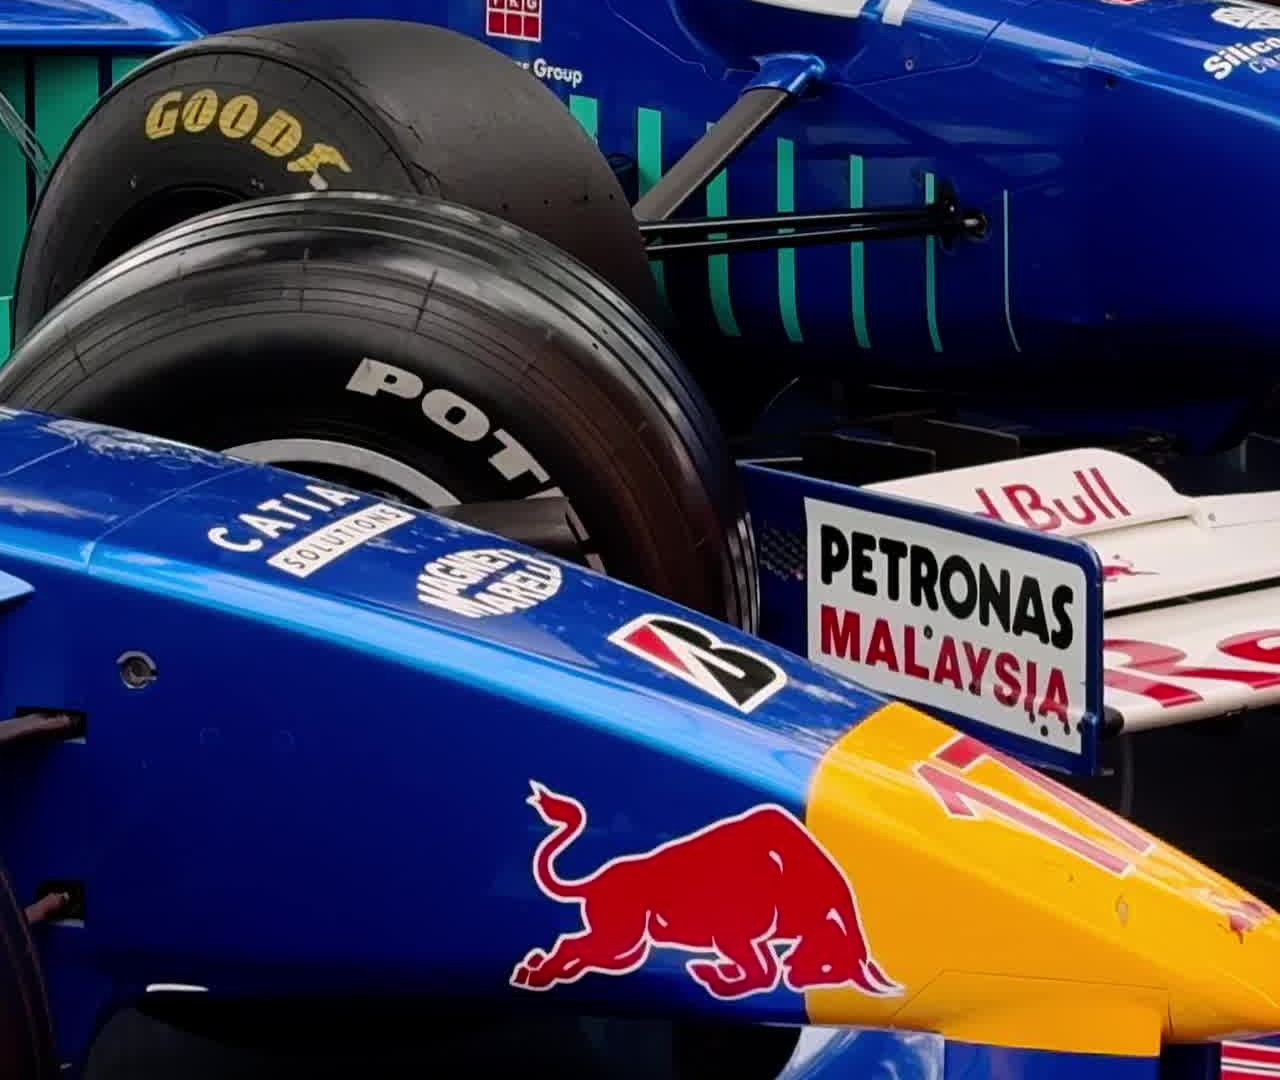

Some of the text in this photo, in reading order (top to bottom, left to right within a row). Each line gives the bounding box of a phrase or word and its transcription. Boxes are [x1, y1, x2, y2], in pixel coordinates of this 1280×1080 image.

[532, 57, 584, 88] Group
[207, 484, 361, 553] CATIA
[1000, 467, 1132, 532] Bull
[282, 505, 407, 570] SOLUTIONS
[820, 524, 1074, 651] PETRONAS
[820, 603, 1071, 730] MALAYSIA
